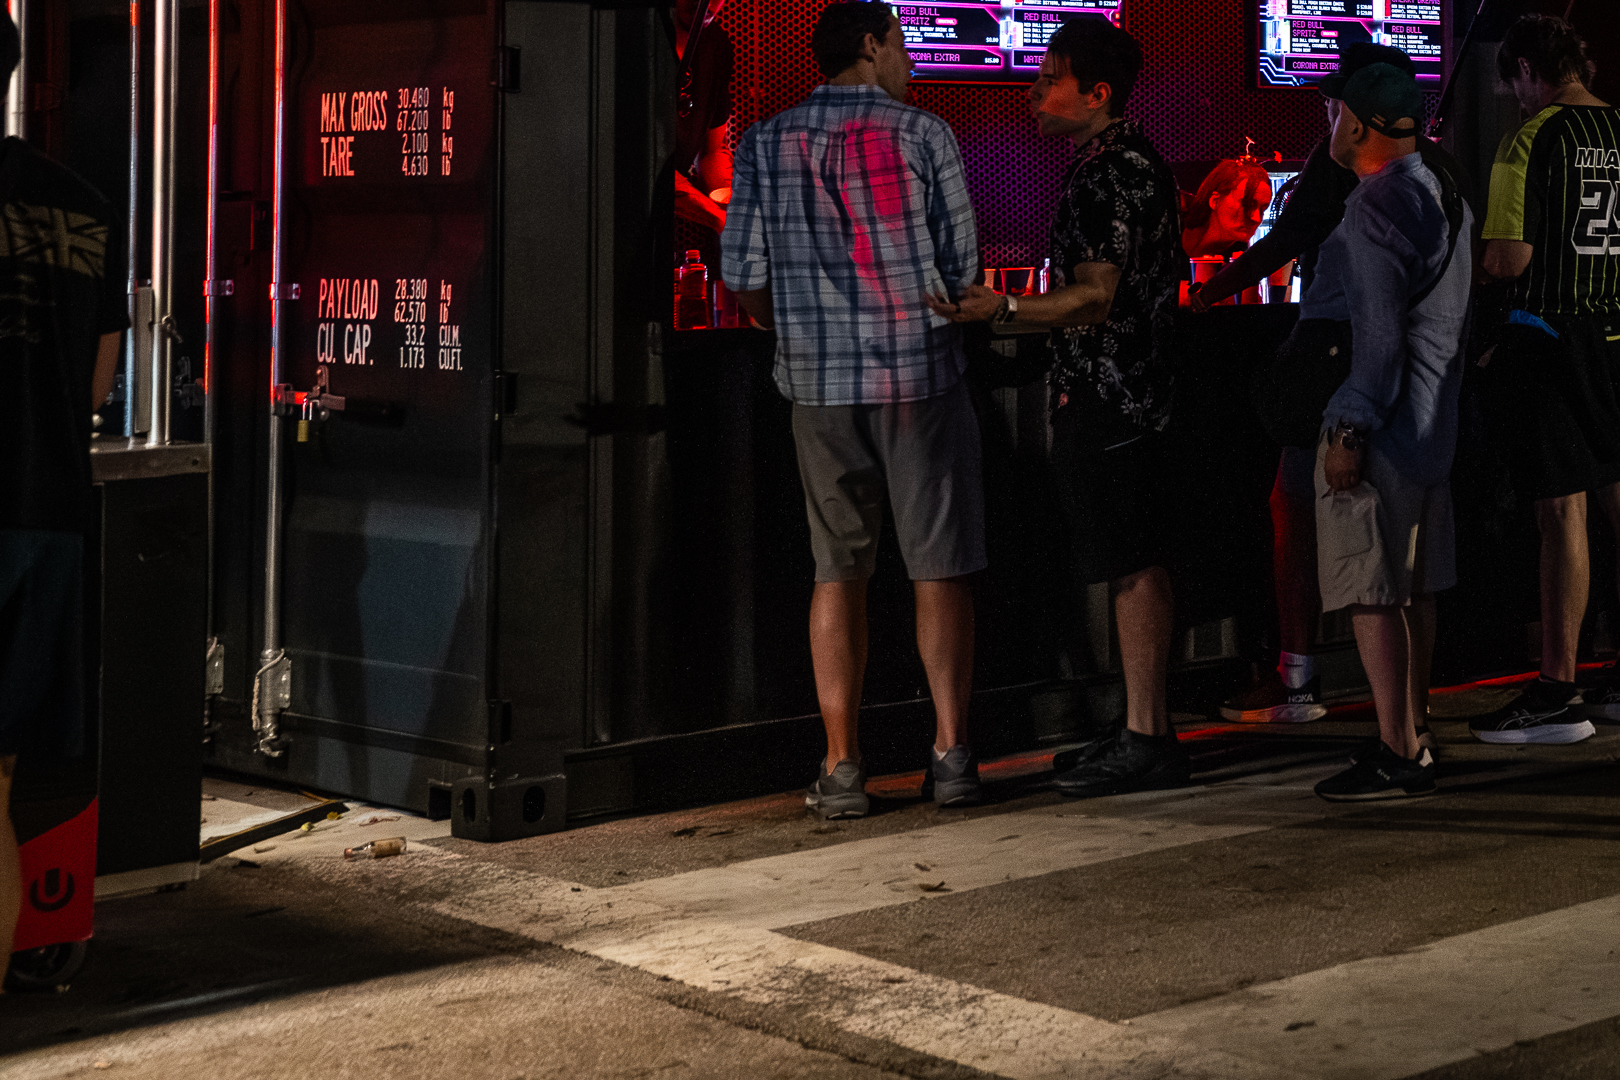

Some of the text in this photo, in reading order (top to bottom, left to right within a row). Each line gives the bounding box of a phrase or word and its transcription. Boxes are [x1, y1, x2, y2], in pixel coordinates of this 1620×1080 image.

[900, 7, 940, 16] RED BULL
[1024, 13, 1061, 22] RED BULL
[900, 17, 930, 25] SPRITZ
[1292, 20, 1324, 29] RED BULL
[1292, 29, 1317, 38] SPRITZ
[1406, 26, 1422, 34] BULL
[908, 52, 961, 62] RONA EXTRA
[1024, 55, 1043, 64] WATE
[1292, 61, 1318, 69] CORONA
[442, 86, 455, 113] kg
[321, 90, 388, 132] MAX GROSS
[442, 109, 452, 130] lb
[442, 132, 453, 159] kg
[320, 135, 355, 177] TARE
[441, 155, 451, 176] lb
[318, 278, 379, 320] PAYLOAD
[440, 279, 452, 307] kg
[439, 301, 449, 323] lb
[317, 322, 374, 366] CU. CAP.
[1288, 693, 1314, 704] HOKA
